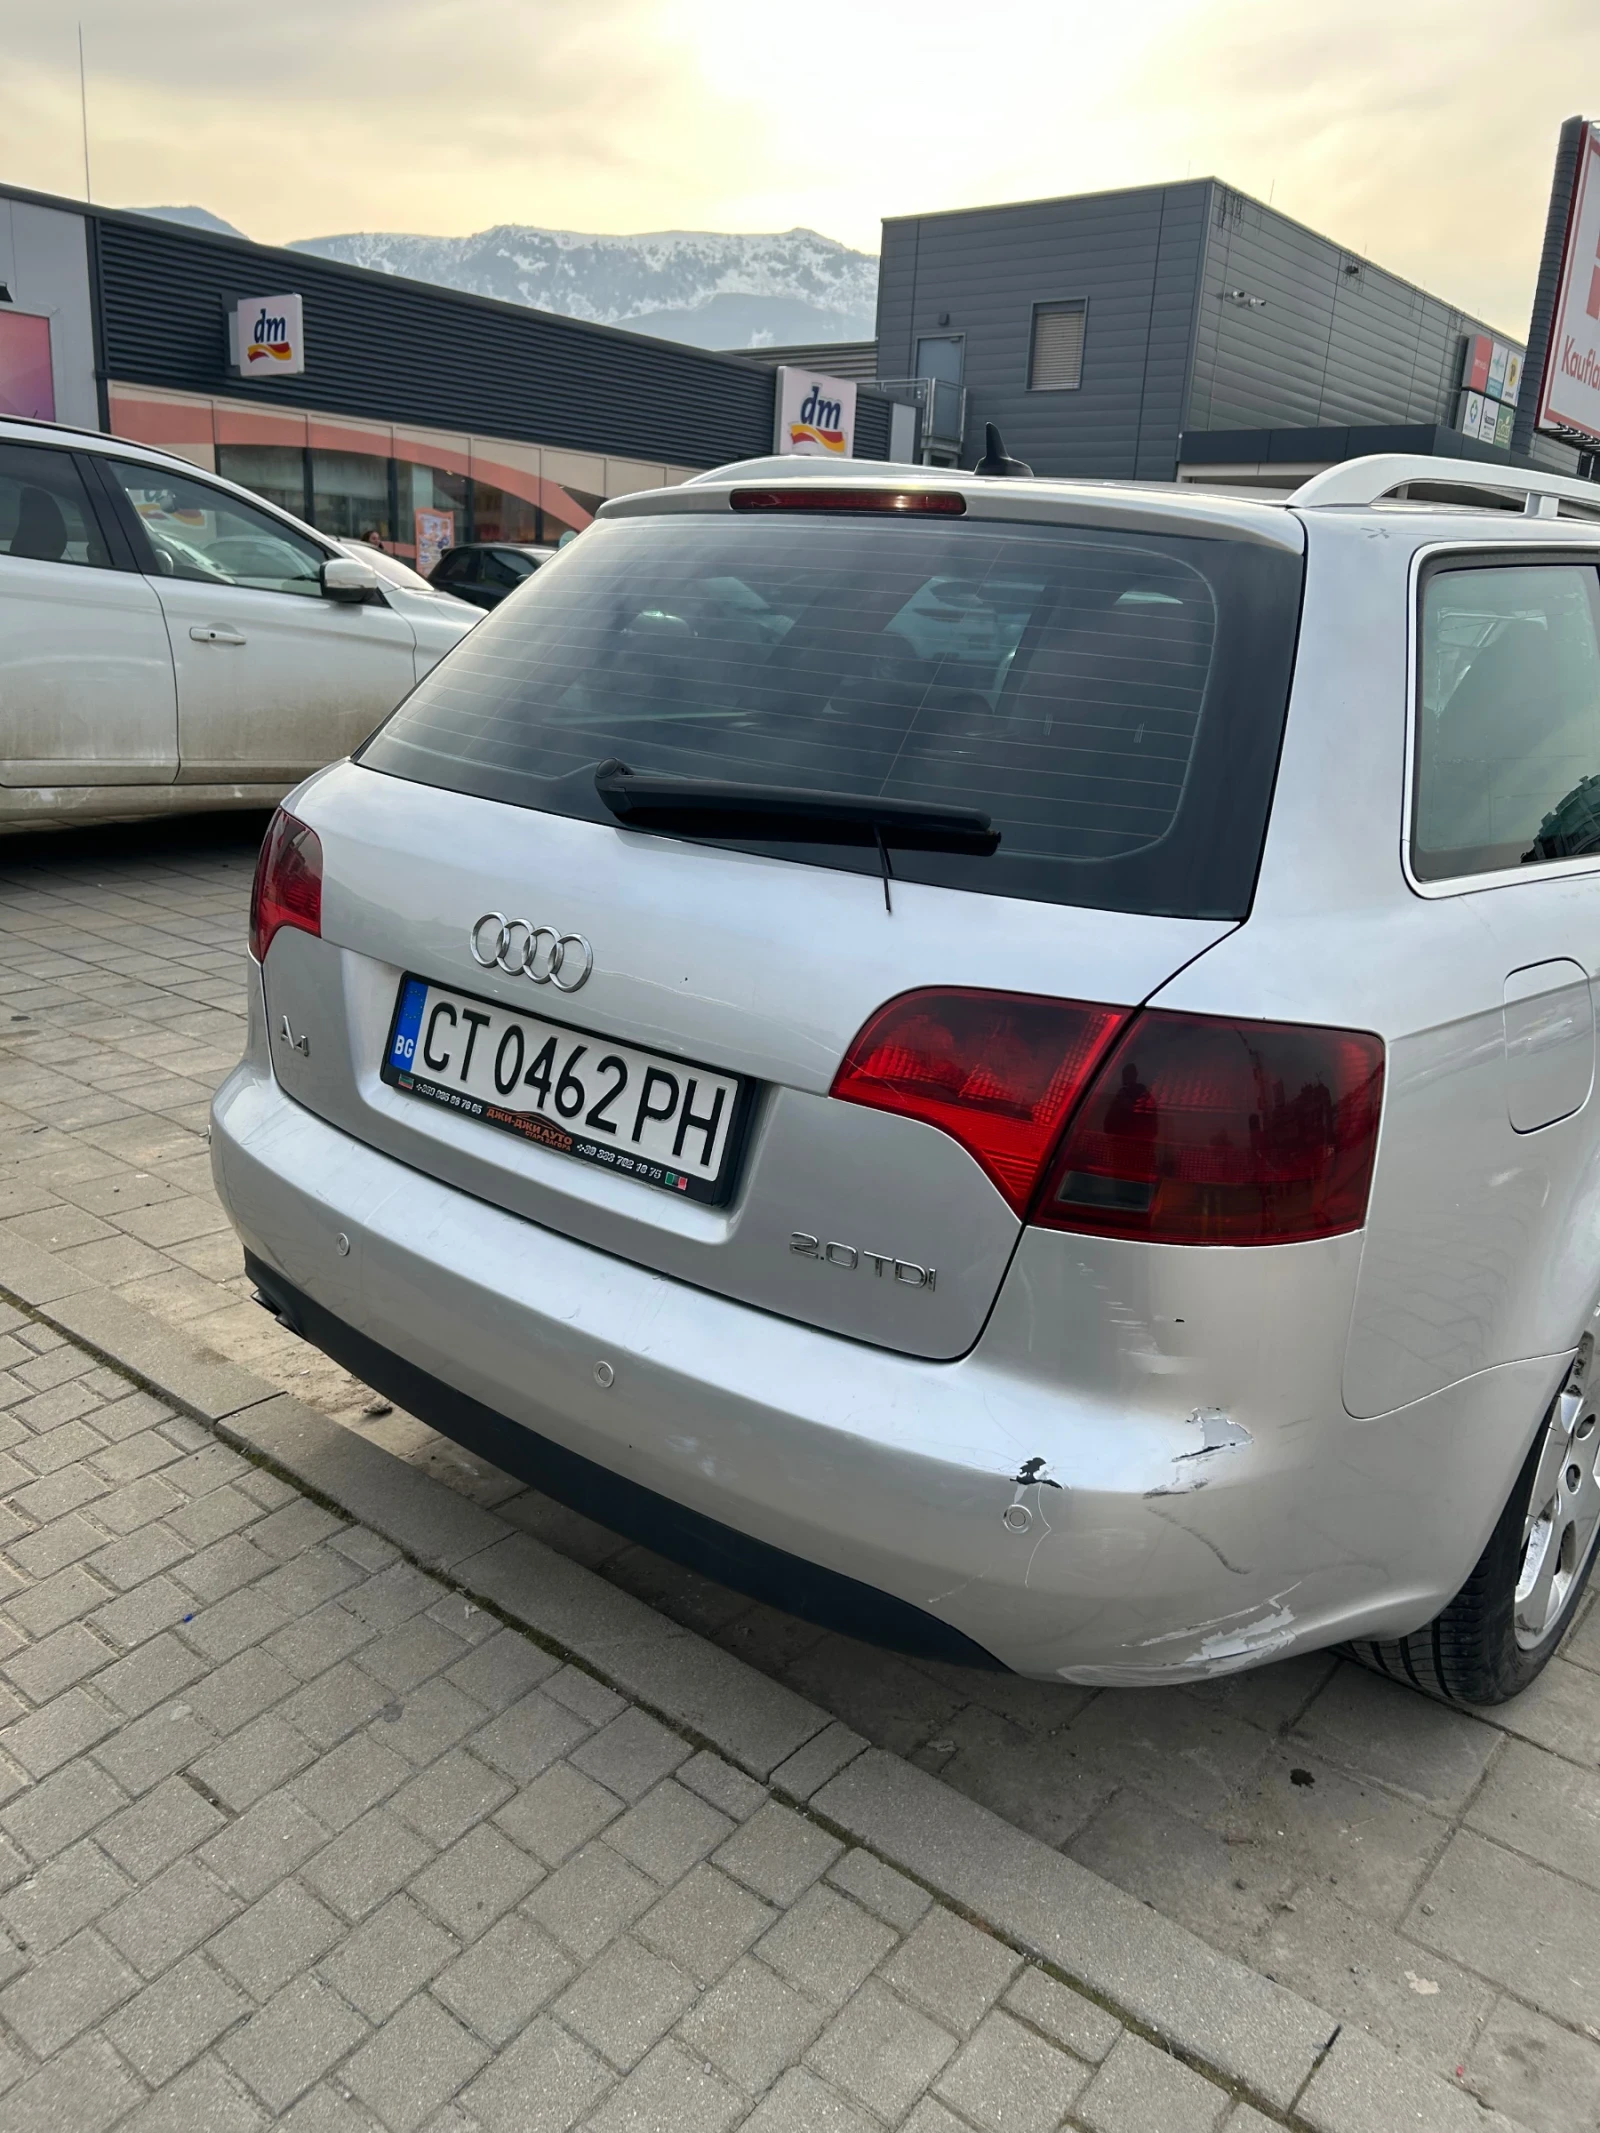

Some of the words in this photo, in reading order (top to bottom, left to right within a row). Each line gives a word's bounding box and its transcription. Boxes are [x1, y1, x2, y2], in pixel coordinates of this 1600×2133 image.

[253, 308, 287, 343] dm
[800, 386, 841, 430] dm
[280, 1014, 310, 1057] A4
[394, 1034, 415, 1059] BG
[542, 1129, 573, 1146] АУТО
[789, 1231, 859, 1270] 2.0
[863, 1250, 937, 1293] TDI
